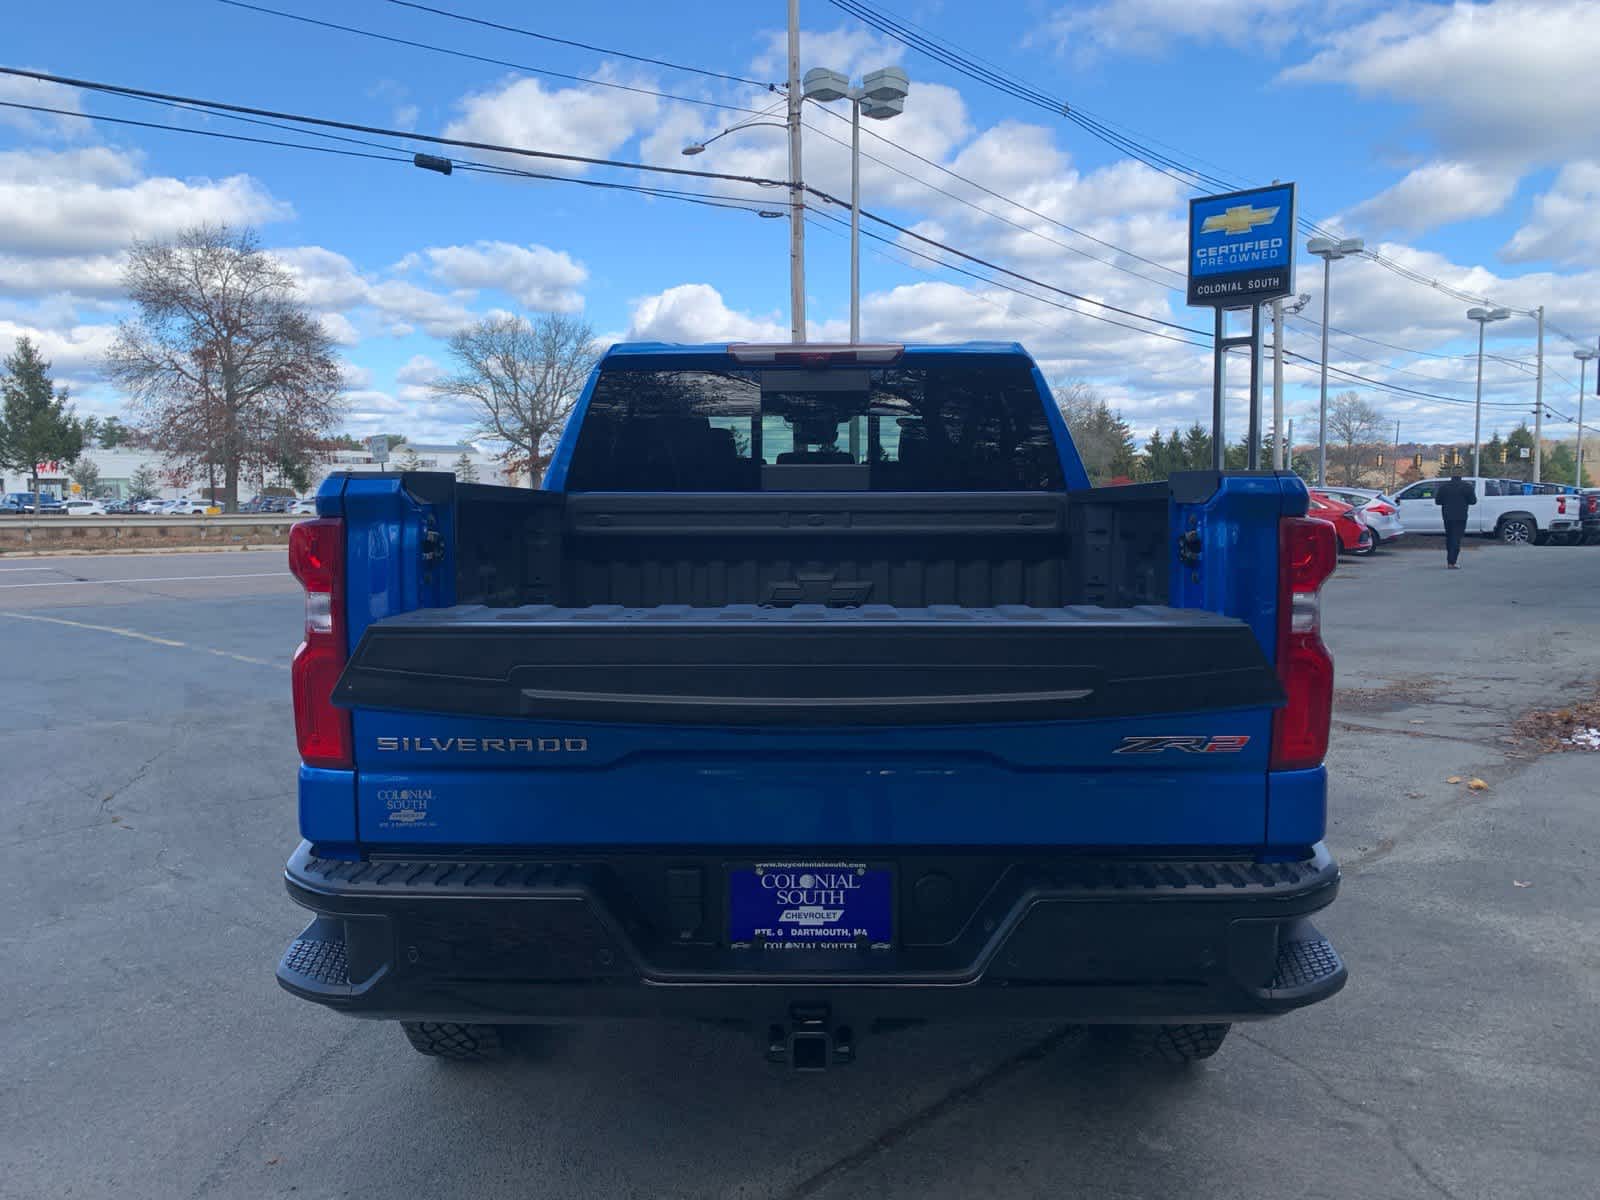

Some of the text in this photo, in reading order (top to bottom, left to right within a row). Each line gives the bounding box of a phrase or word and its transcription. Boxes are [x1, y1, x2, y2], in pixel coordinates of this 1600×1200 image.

[1196, 238, 1283, 258] CERTIFIED
[1197, 277, 1280, 295] COLONIAL SOUTH
[377, 737, 588, 752] SILVERADO
[1112, 735, 1251, 753] ZR2
[377, 790, 433, 800] COLONIAL
[386, 800, 428, 810] SOUTH
[761, 874, 860, 888] COLONIAL
[776, 890, 846, 905] SOUTH
[785, 911, 838, 920] CHEVROLET
[790, 928, 851, 938] DARTMOUTH,
[853, 928, 868, 937] MA
